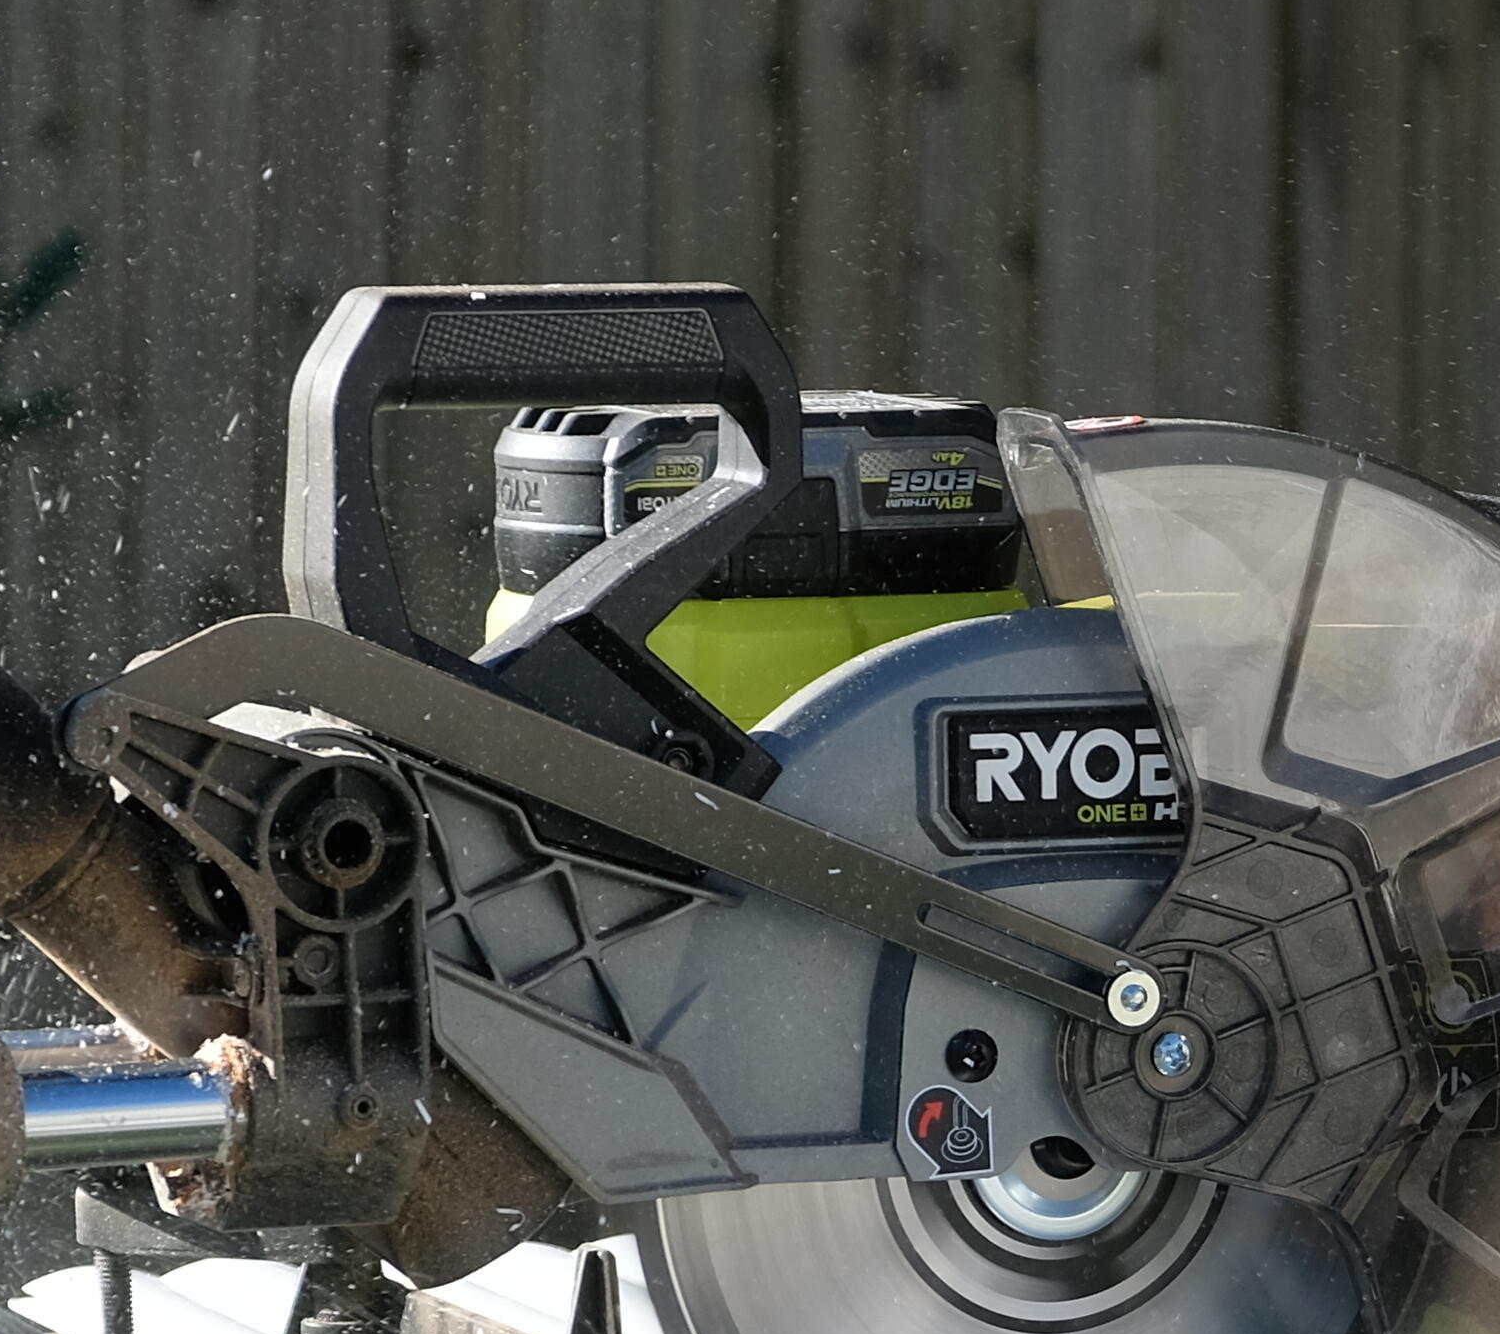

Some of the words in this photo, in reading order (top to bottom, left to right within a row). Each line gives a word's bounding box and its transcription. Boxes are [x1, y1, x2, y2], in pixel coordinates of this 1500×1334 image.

[932, 451, 965, 466] 4Ah
[889, 469, 977, 492] EDGE
[499, 476, 543, 514] RYO
[636, 496, 675, 512] OBI
[1154, 802, 1179, 821] H
